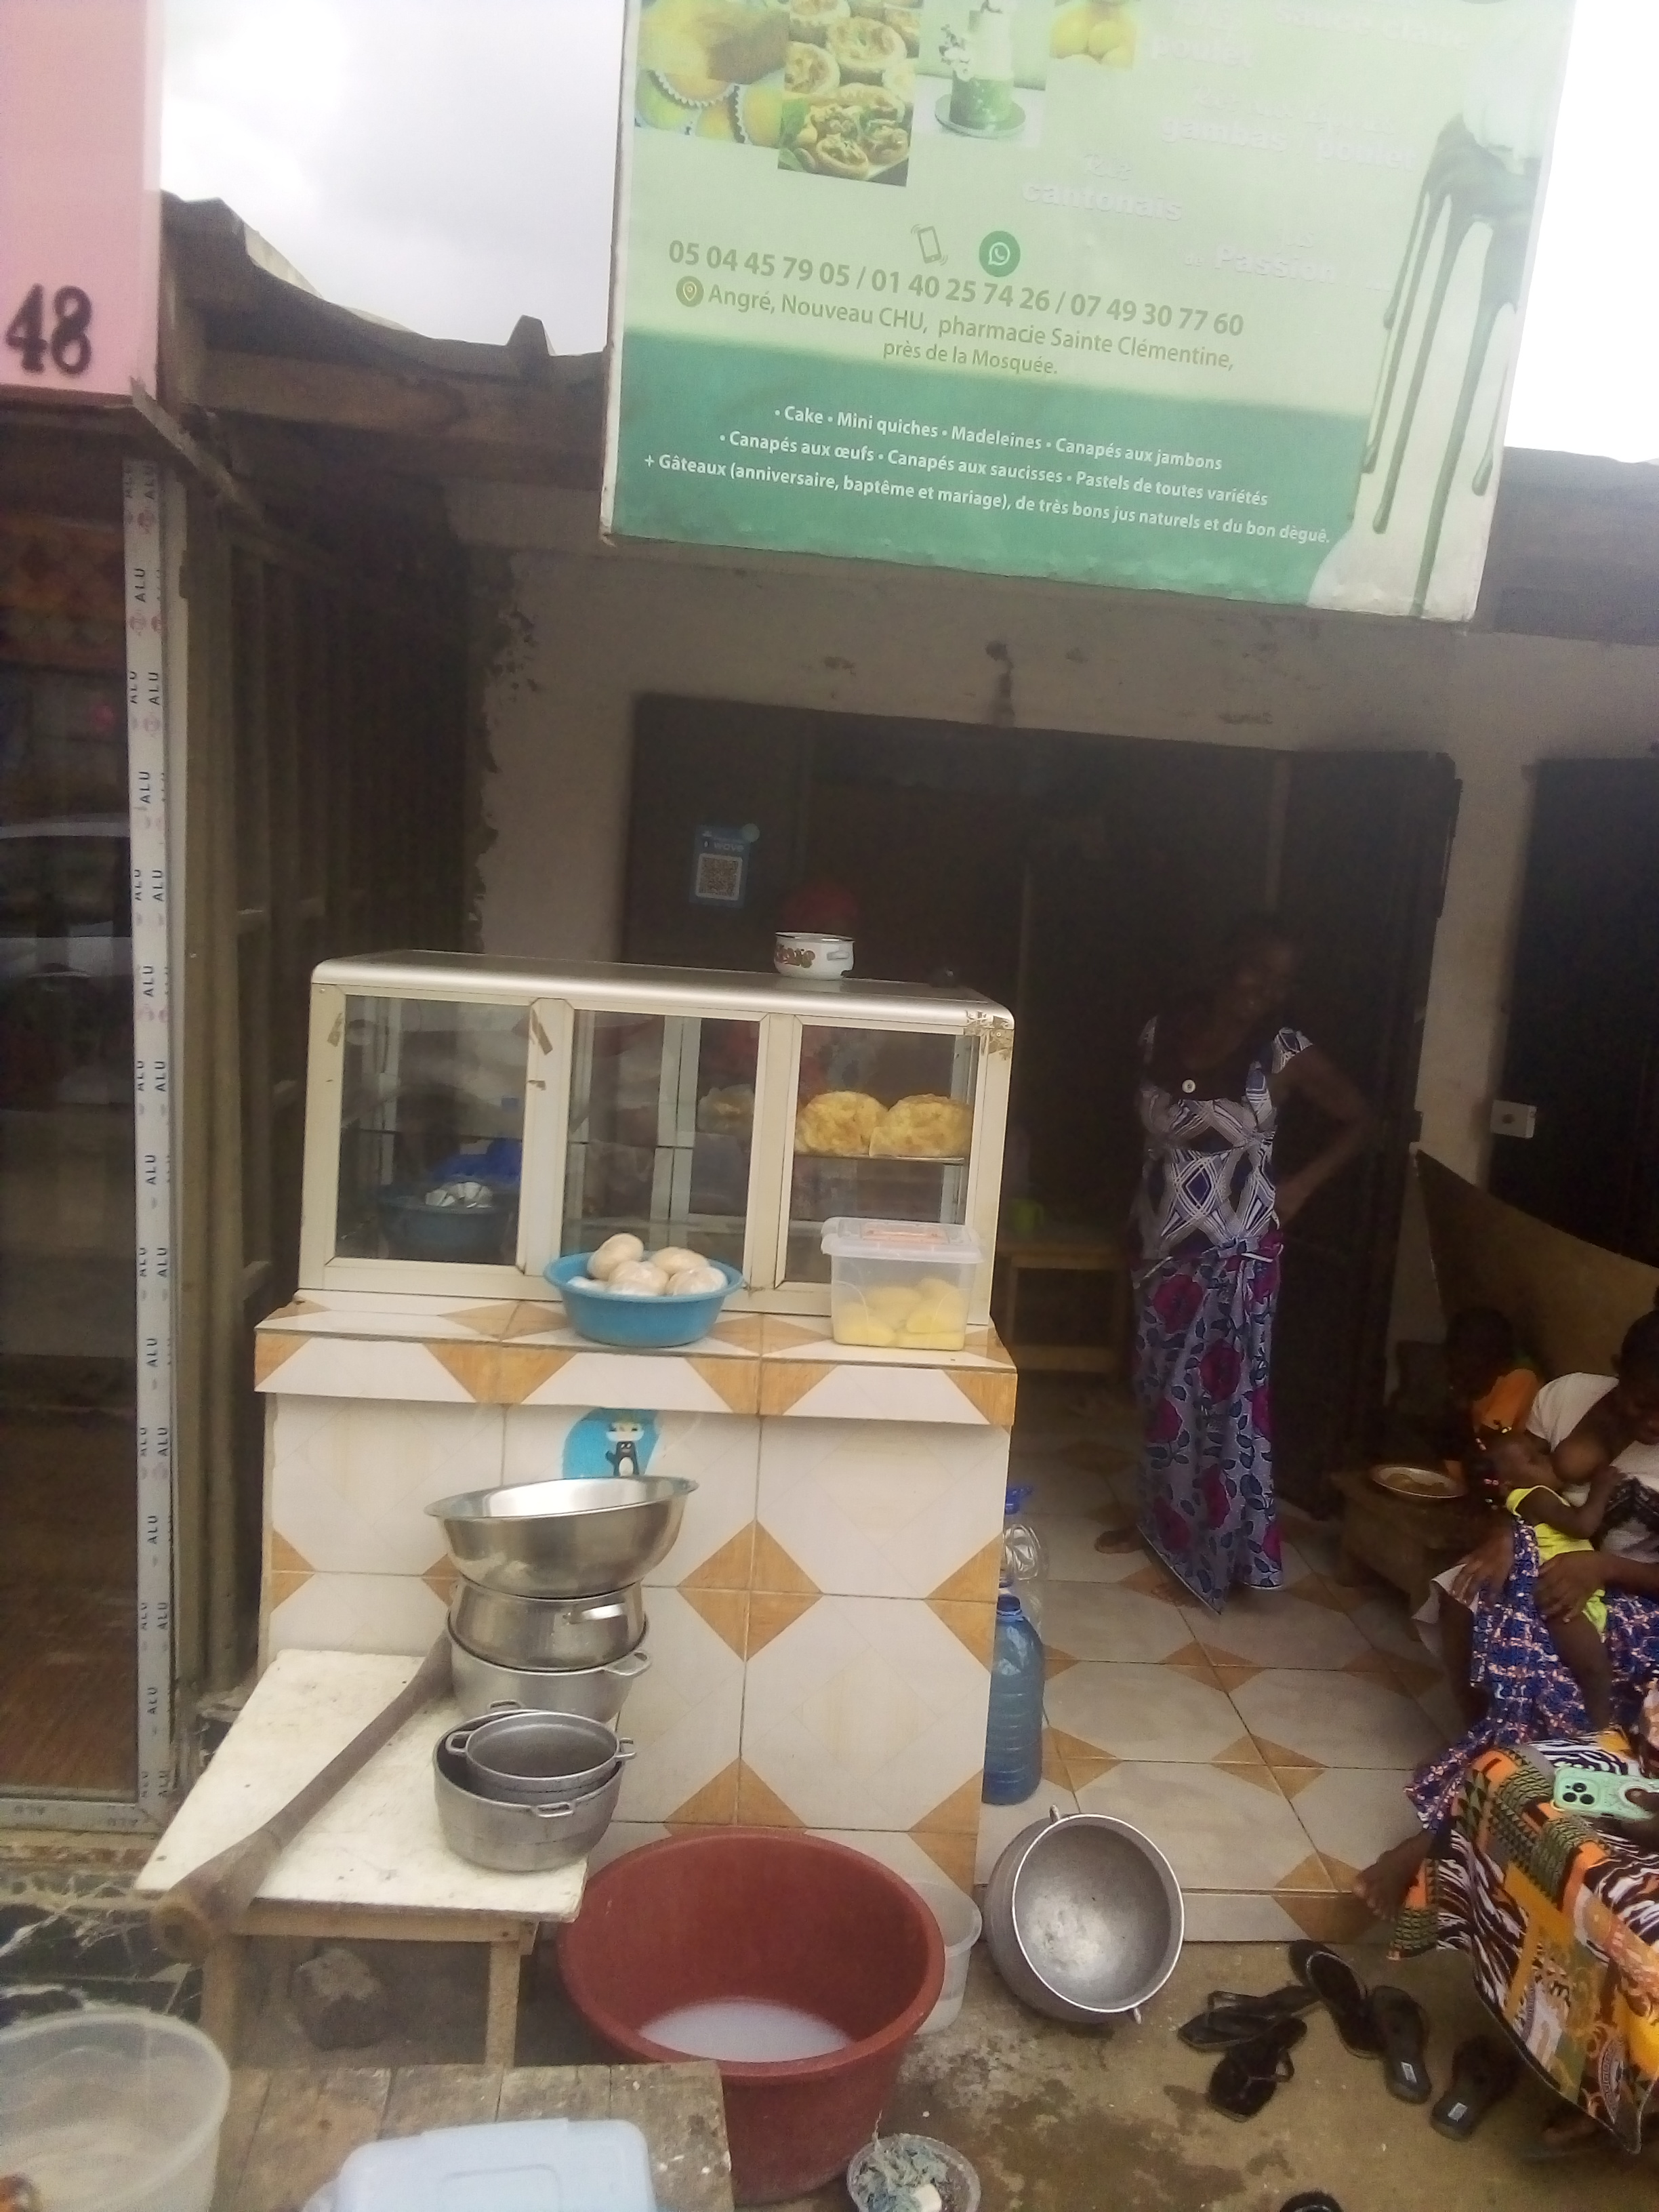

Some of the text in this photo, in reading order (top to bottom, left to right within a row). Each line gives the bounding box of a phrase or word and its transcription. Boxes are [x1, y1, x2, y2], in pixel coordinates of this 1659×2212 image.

[1021, 180, 1182, 222] cantonais
[1214, 243, 1336, 285] Passion
[668, 239, 1244, 337] 05 04 45 79 05 / 01 40 25 74 26 / 07 49 30 77 60
[5, 283, 92, 377] 48
[708, 284, 1234, 372] Angré, Nouveau CHU, pharmacie Sainte Clémentine,
[883, 340, 1057, 374] près de la Mosquée.
[783, 405, 1223, 470] Cake Mini quiches Madeleines Canapés aux jambons
[729, 430, 1269, 506] Canapés aux œufs Canapés aux saucisses Pastels de toutes variétés
[658, 453, 727, 476] Gâteaux
[730, 462, 840, 491] (anniversaire,
[843, 474, 915, 498] baptême
[918, 487, 935, 500] et
[937, 489, 1012, 511] mariage),
[1015, 495, 1036, 512] de
[1038, 498, 1069, 515] très
[1071, 500, 1110, 519] bons
[1111, 506, 1136, 524] jus
[1139, 512, 1201, 529] naturels
[1203, 518, 1220, 531] et
[1222, 518, 1243, 534] du
[1246, 520, 1276, 537] bon
[134, 568, 146, 602] ALU
[148, 672, 161, 705] ALU
[139, 771, 150, 804] ALU
[152, 869, 163, 901] ALU
[142, 965, 154, 998] ALU
[154, 1061, 167, 1092] ALU
[145, 1154, 157, 1185] ALU
[157, 1248, 167, 1277] ALU
[147, 1338, 158, 1368] ALU
[157, 1427, 169, 1457] ALU
[147, 1515, 158, 1544] ALU
[157, 1602, 168, 1630] ALU
[147, 1687, 158, 1715] ALU
